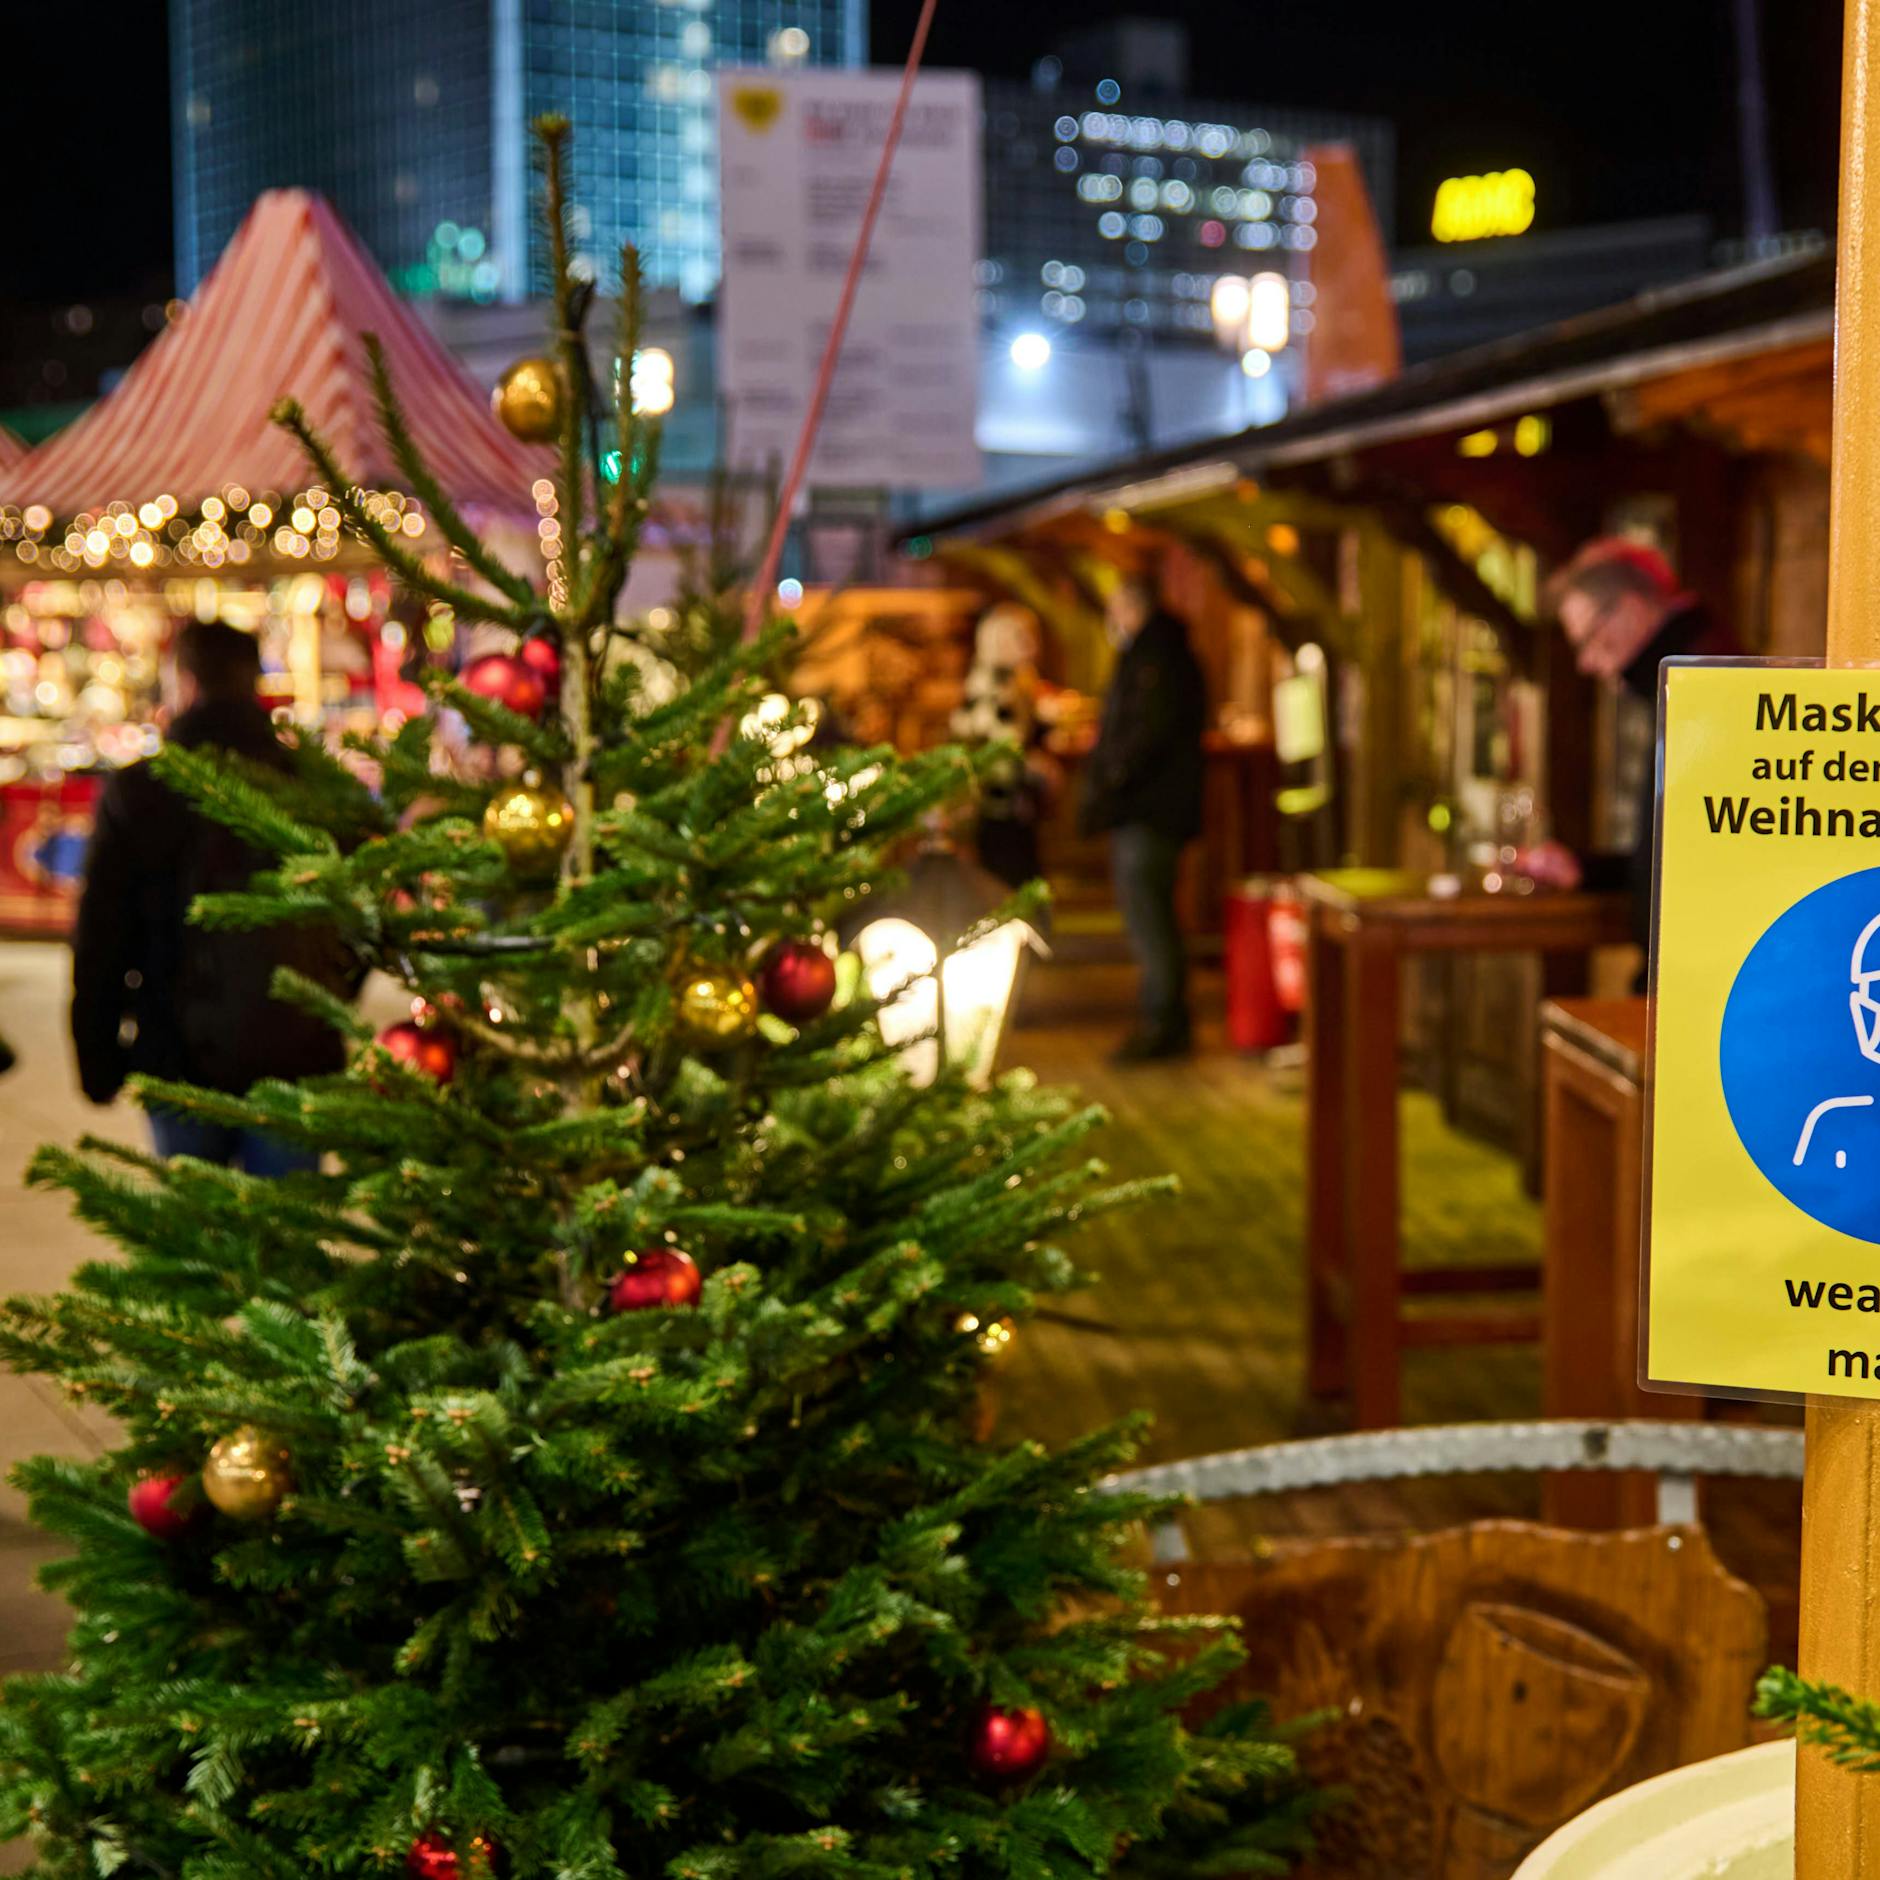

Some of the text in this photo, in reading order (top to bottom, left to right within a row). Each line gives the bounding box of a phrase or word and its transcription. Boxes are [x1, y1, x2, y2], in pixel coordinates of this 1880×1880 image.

[1755, 692, 1880, 733] Mask
[1751, 749, 1815, 781] auf
[1703, 795, 1880, 838] Weihna
[1784, 1279, 1880, 1313] wea
[1828, 1349, 1880, 1381] m
